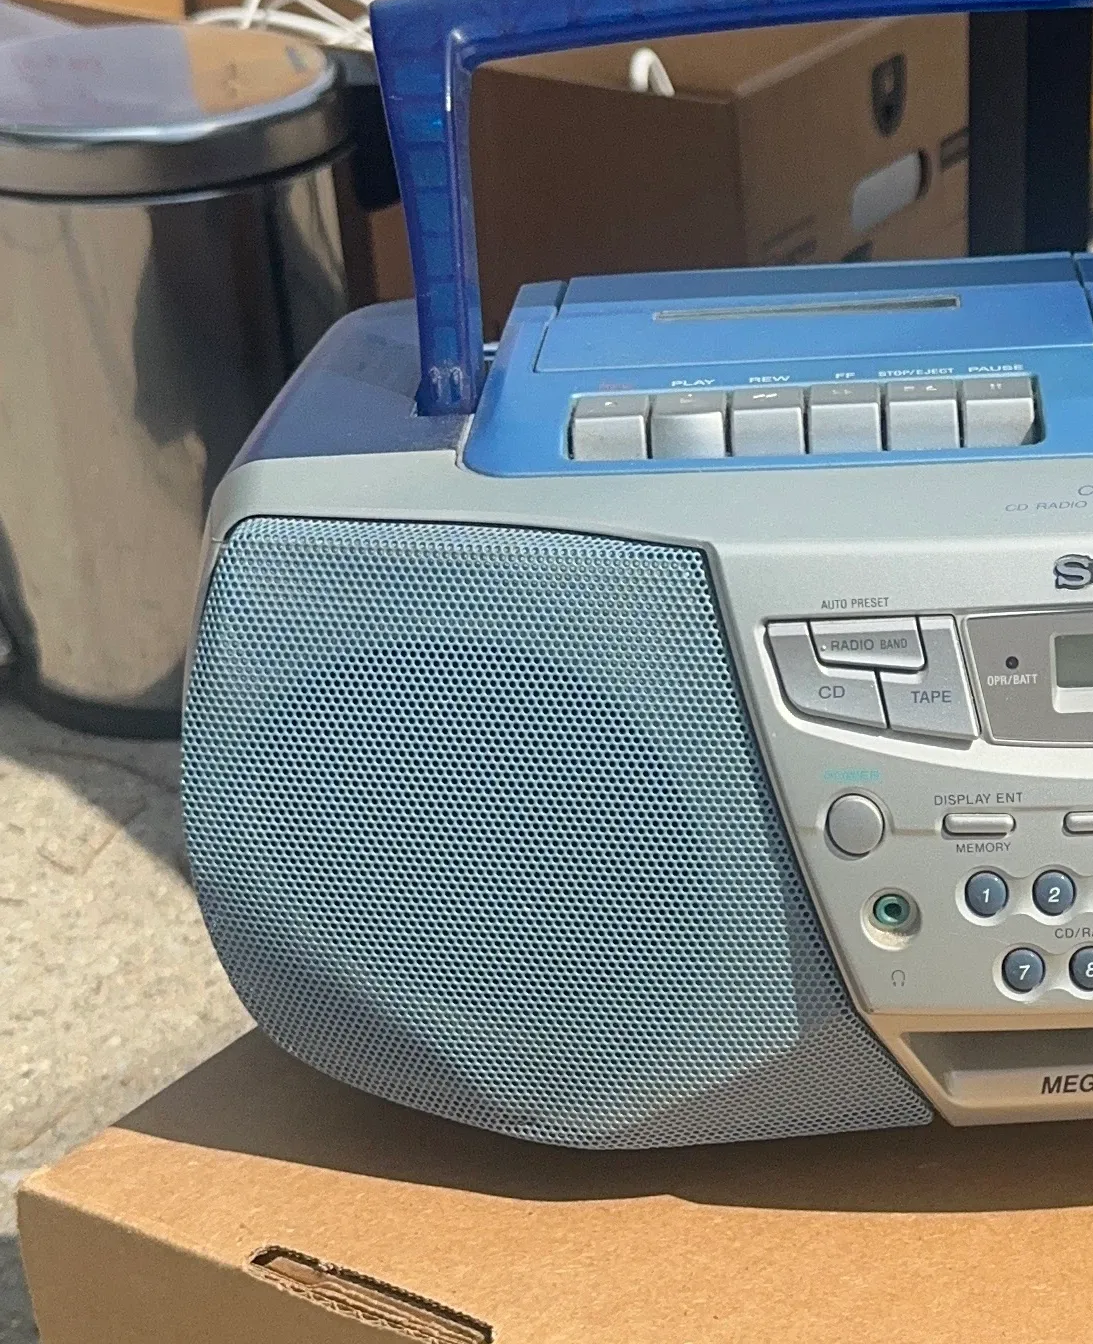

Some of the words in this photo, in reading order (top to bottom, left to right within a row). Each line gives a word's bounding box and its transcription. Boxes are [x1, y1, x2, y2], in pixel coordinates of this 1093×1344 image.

[878, 367, 955, 377] STOP/EJECT
[968, 364, 1024, 373] PAUSE
[671, 379, 715, 387] PLAY
[749, 375, 791, 383] REW
[1005, 503, 1029, 512] CD
[1036, 500, 1088, 511] RADIO
[821, 599, 848, 610] AUTO
[851, 597, 889, 608] PRESET
[830, 640, 875, 652] RADIO
[880, 638, 908, 650] BAND
[987, 674, 1038, 686] OPR/BATT
[818, 685, 846, 699] CD
[911, 690, 952, 703] TAPE
[934, 793, 992, 806] DISPLAY
[996, 792, 1024, 804] ENT
[956, 842, 1011, 853] MEMORY
[982, 887, 992, 903] 1
[1048, 887, 1061, 903] 2
[1018, 965, 1030, 981] 7
